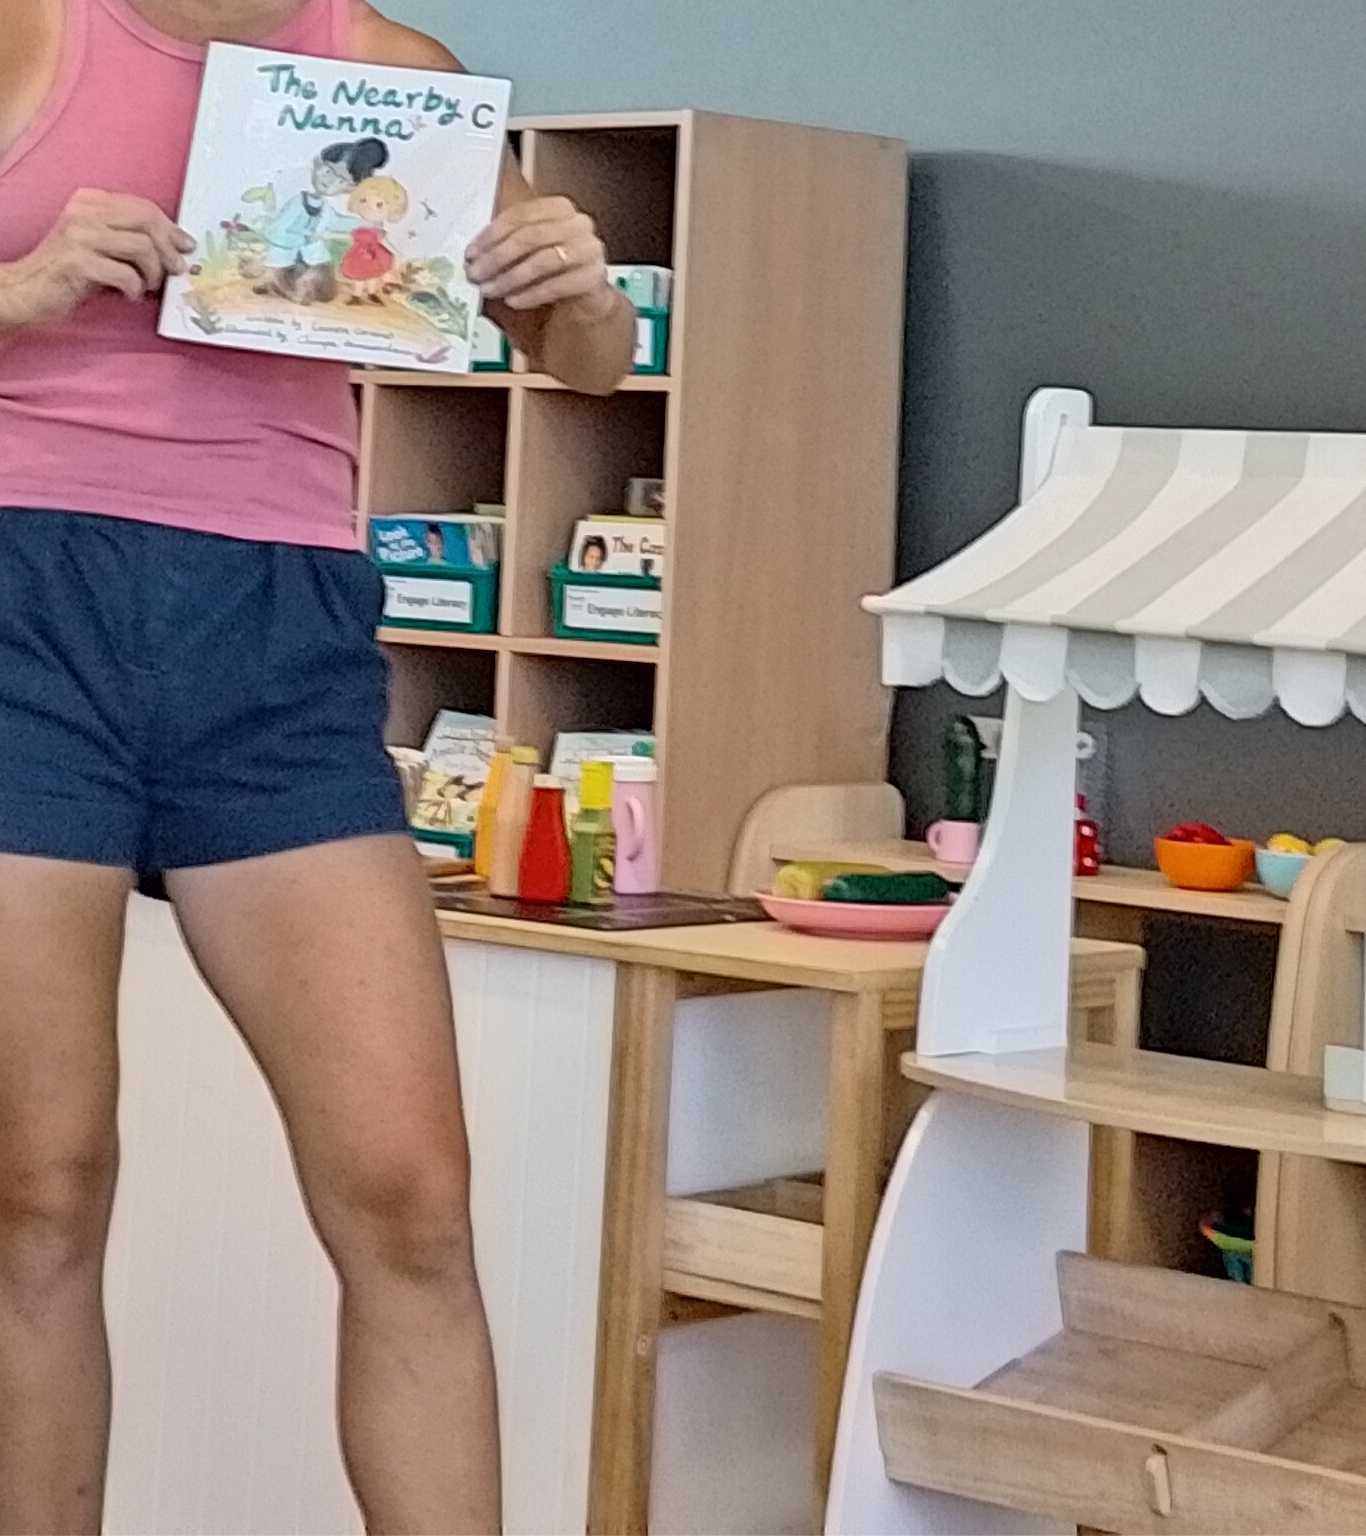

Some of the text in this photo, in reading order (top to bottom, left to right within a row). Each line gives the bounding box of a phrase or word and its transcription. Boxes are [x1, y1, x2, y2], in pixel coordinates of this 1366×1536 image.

[257, 63, 463, 126] The Nearby
[277, 104, 414, 140] Nanna
[471, 103, 496, 129] C
[396, 592, 468, 612] Engage Literacy
[587, 603, 663, 621] Engage Literac
